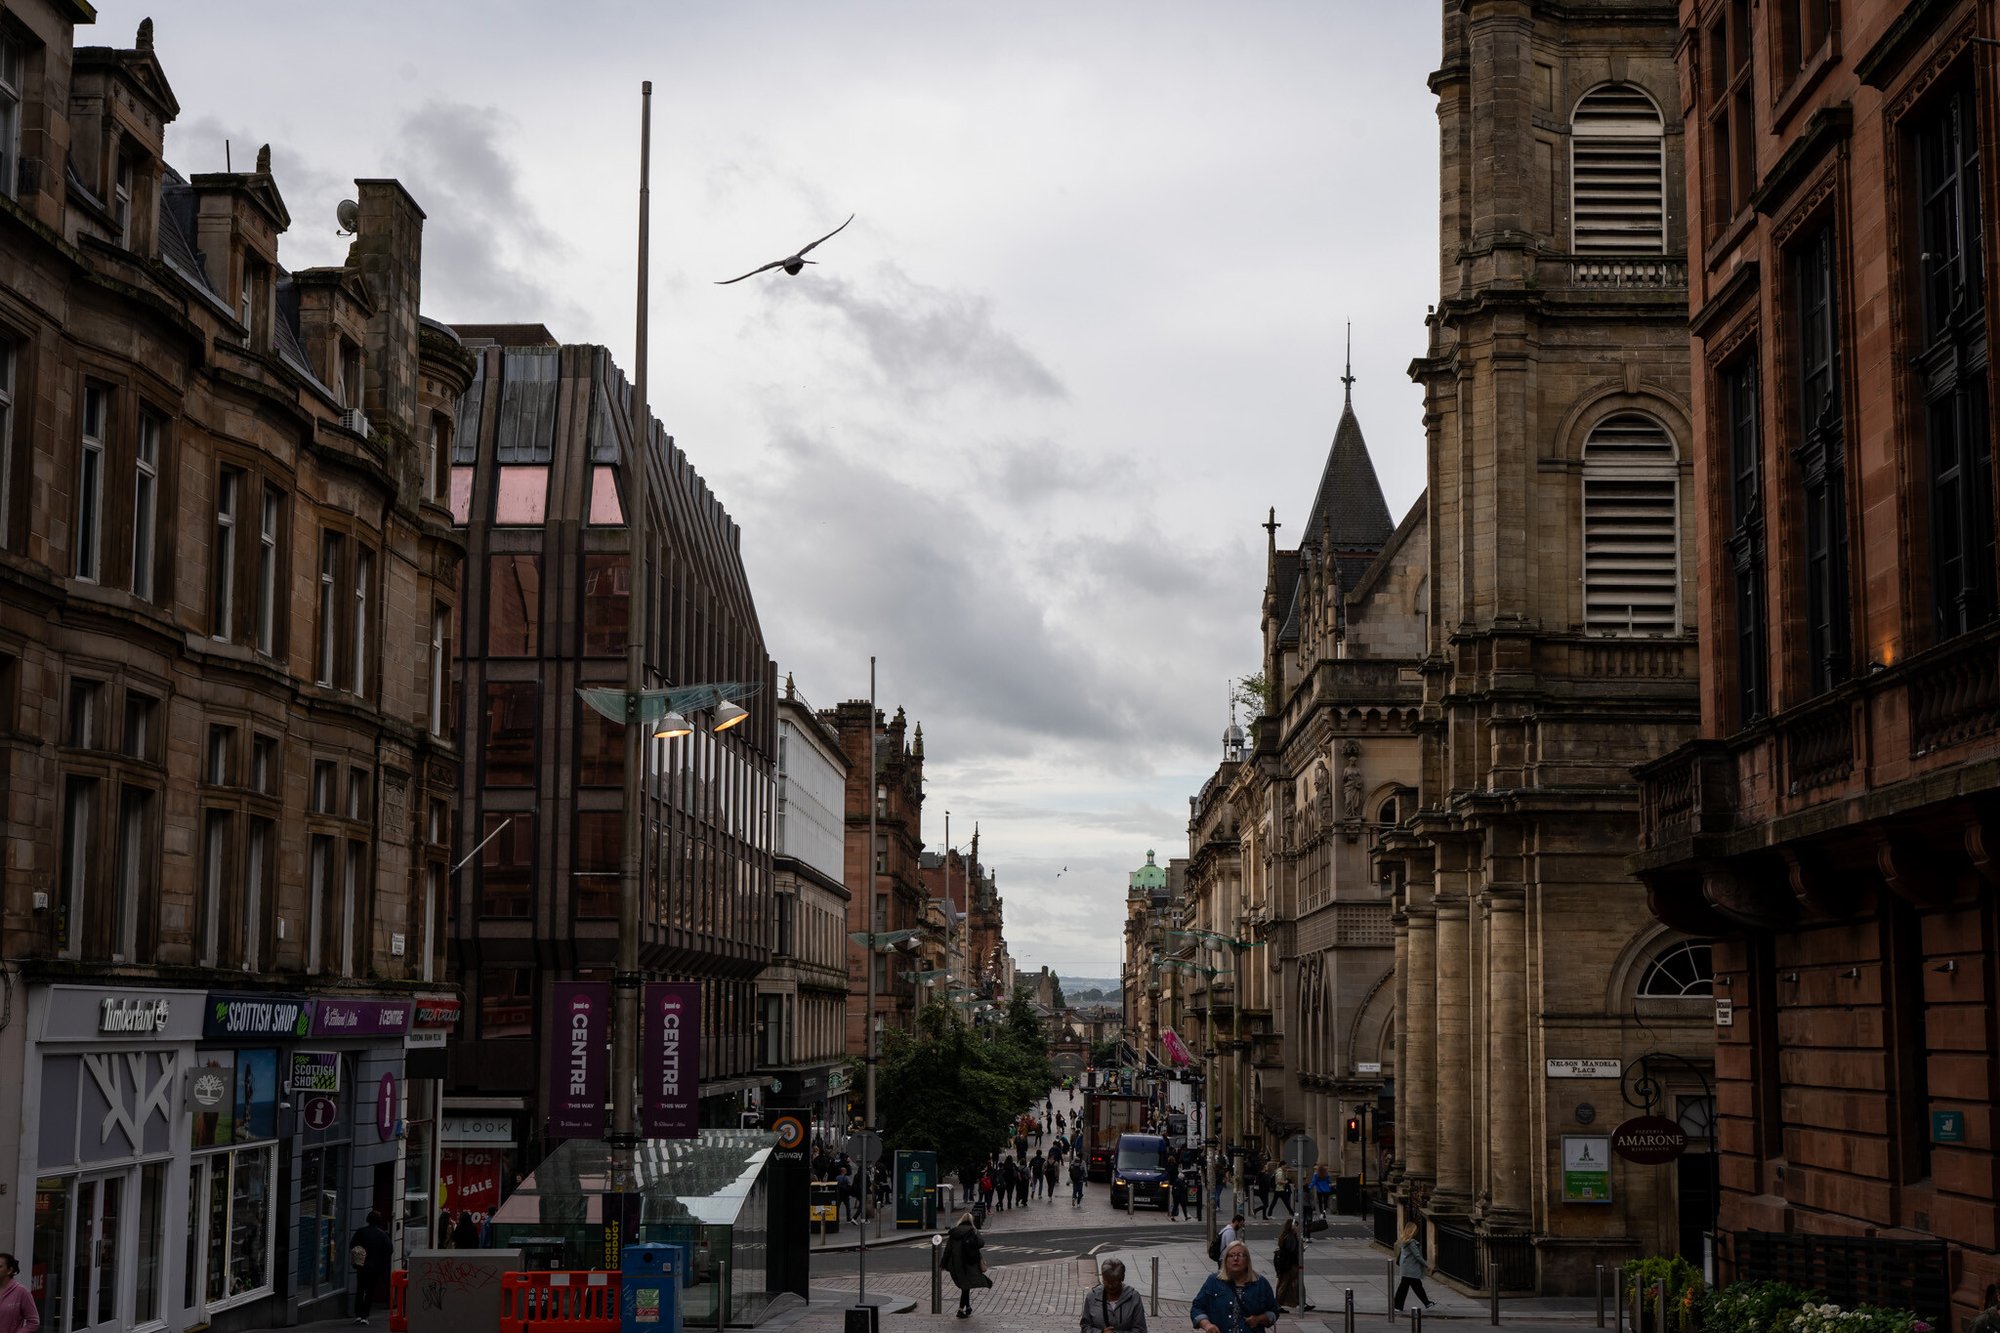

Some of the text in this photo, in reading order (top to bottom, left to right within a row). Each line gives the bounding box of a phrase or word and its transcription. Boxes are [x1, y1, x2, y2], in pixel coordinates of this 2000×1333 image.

[104, 998, 156, 1031] Timberland
[227, 1002, 273, 1031] SCOTTISH
[272, 1004, 298, 1032] SHOP
[569, 1013, 588, 1096] CENTRE
[662, 1013, 680, 1096] CENTRE
[294, 1064, 335, 1076] SCOTTISH
[294, 1076, 316, 1087] SHOP
[462, 1122, 508, 1133] LOOK
[1617, 1135, 1684, 1146] AMARONE
[462, 1179, 493, 1197] SALE
[605, 1226, 612, 1241] OF
